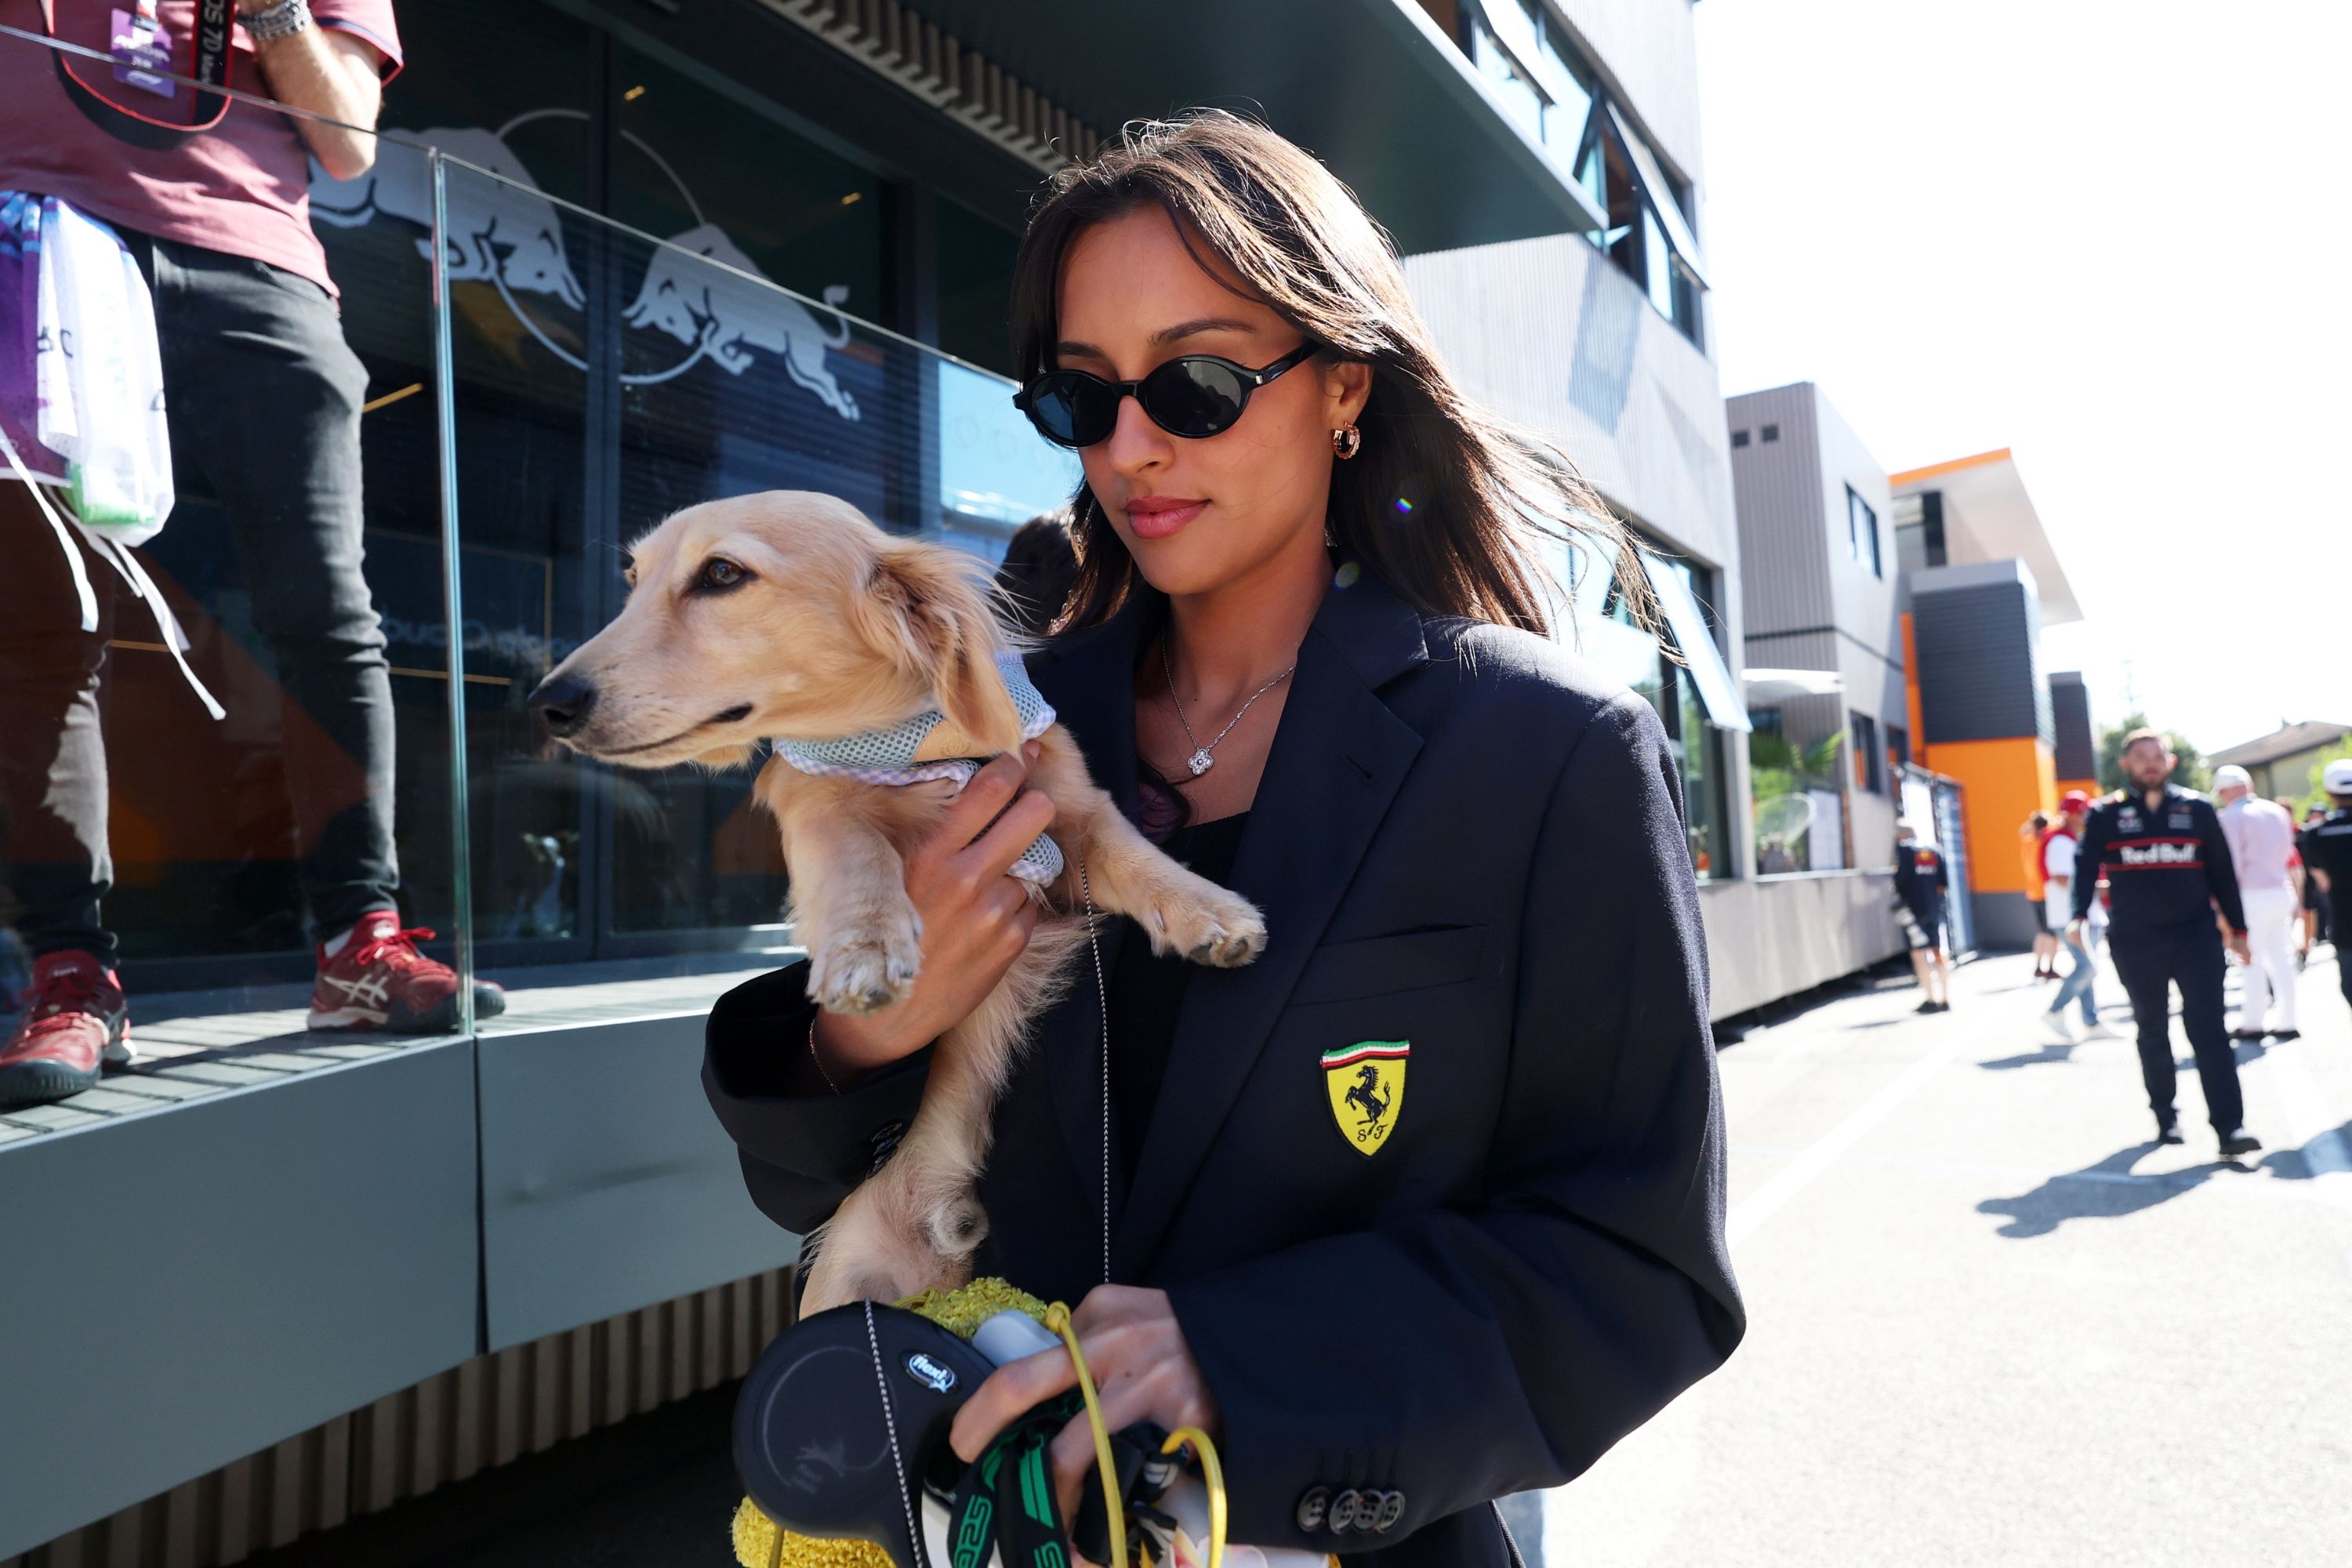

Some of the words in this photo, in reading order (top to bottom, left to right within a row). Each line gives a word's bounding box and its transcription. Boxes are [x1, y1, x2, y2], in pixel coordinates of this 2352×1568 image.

[201, 27, 223, 52] 7D
[2120, 843, 2158, 865] Red
[2160, 843, 2196, 863] Bull
